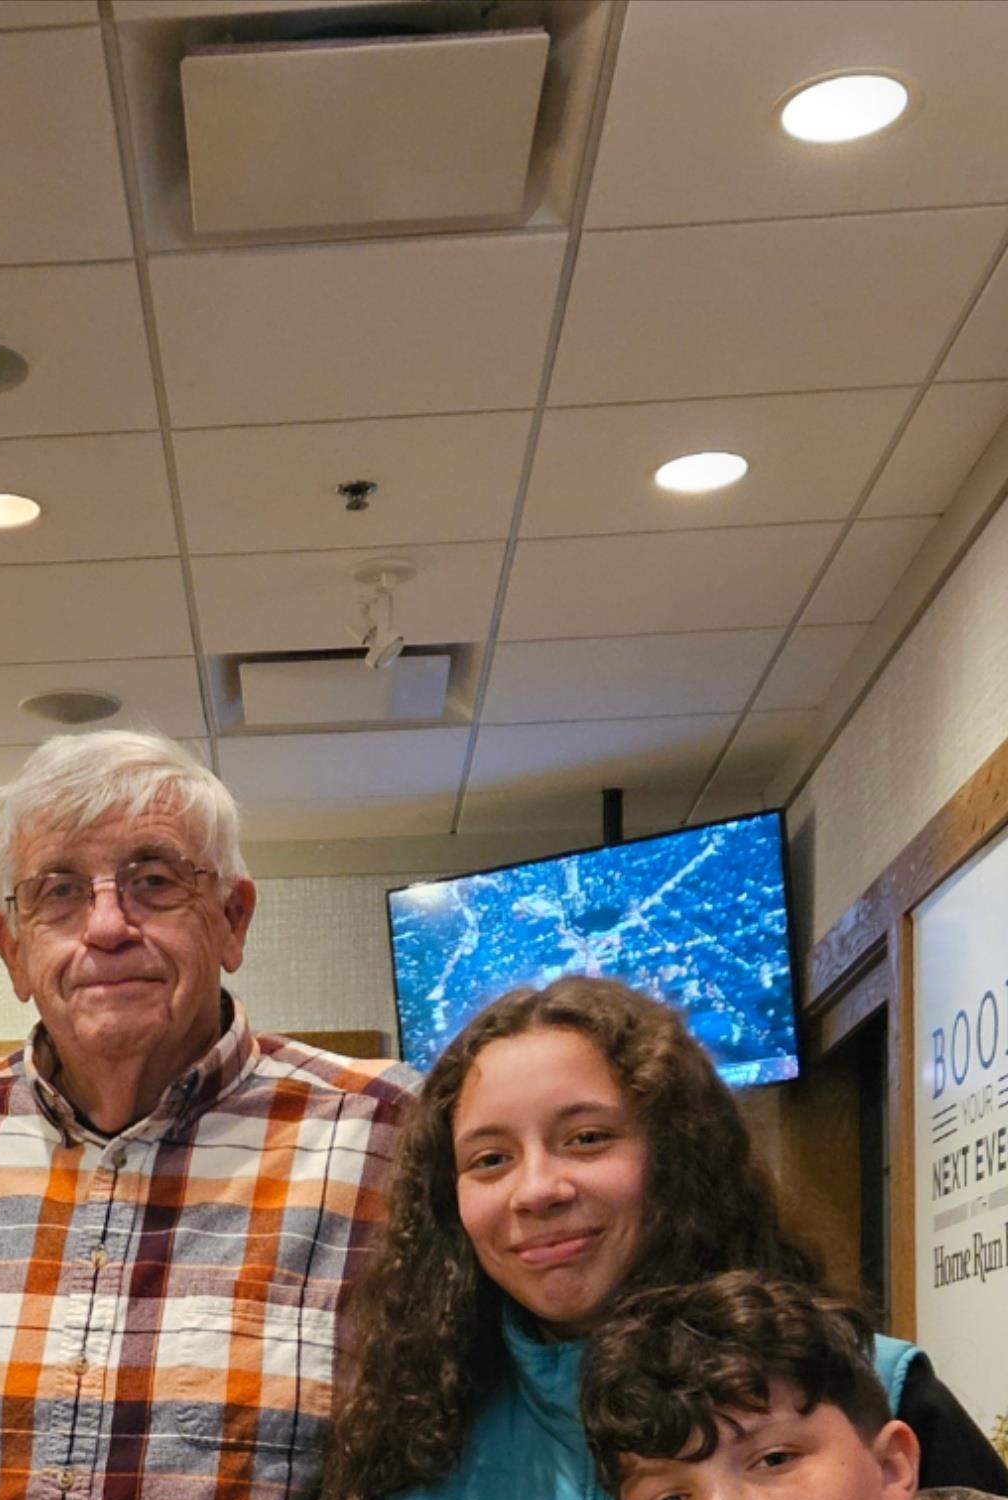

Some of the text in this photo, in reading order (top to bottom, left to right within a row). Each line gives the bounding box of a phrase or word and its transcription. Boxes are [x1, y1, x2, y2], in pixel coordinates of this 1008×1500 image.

[932, 978, 1008, 1100] BOO
[962, 1084, 993, 1126] YOUR
[932, 1145, 971, 1201] NEXT
[934, 1245, 971, 1289] Home
[973, 1232, 1004, 1284] Run
